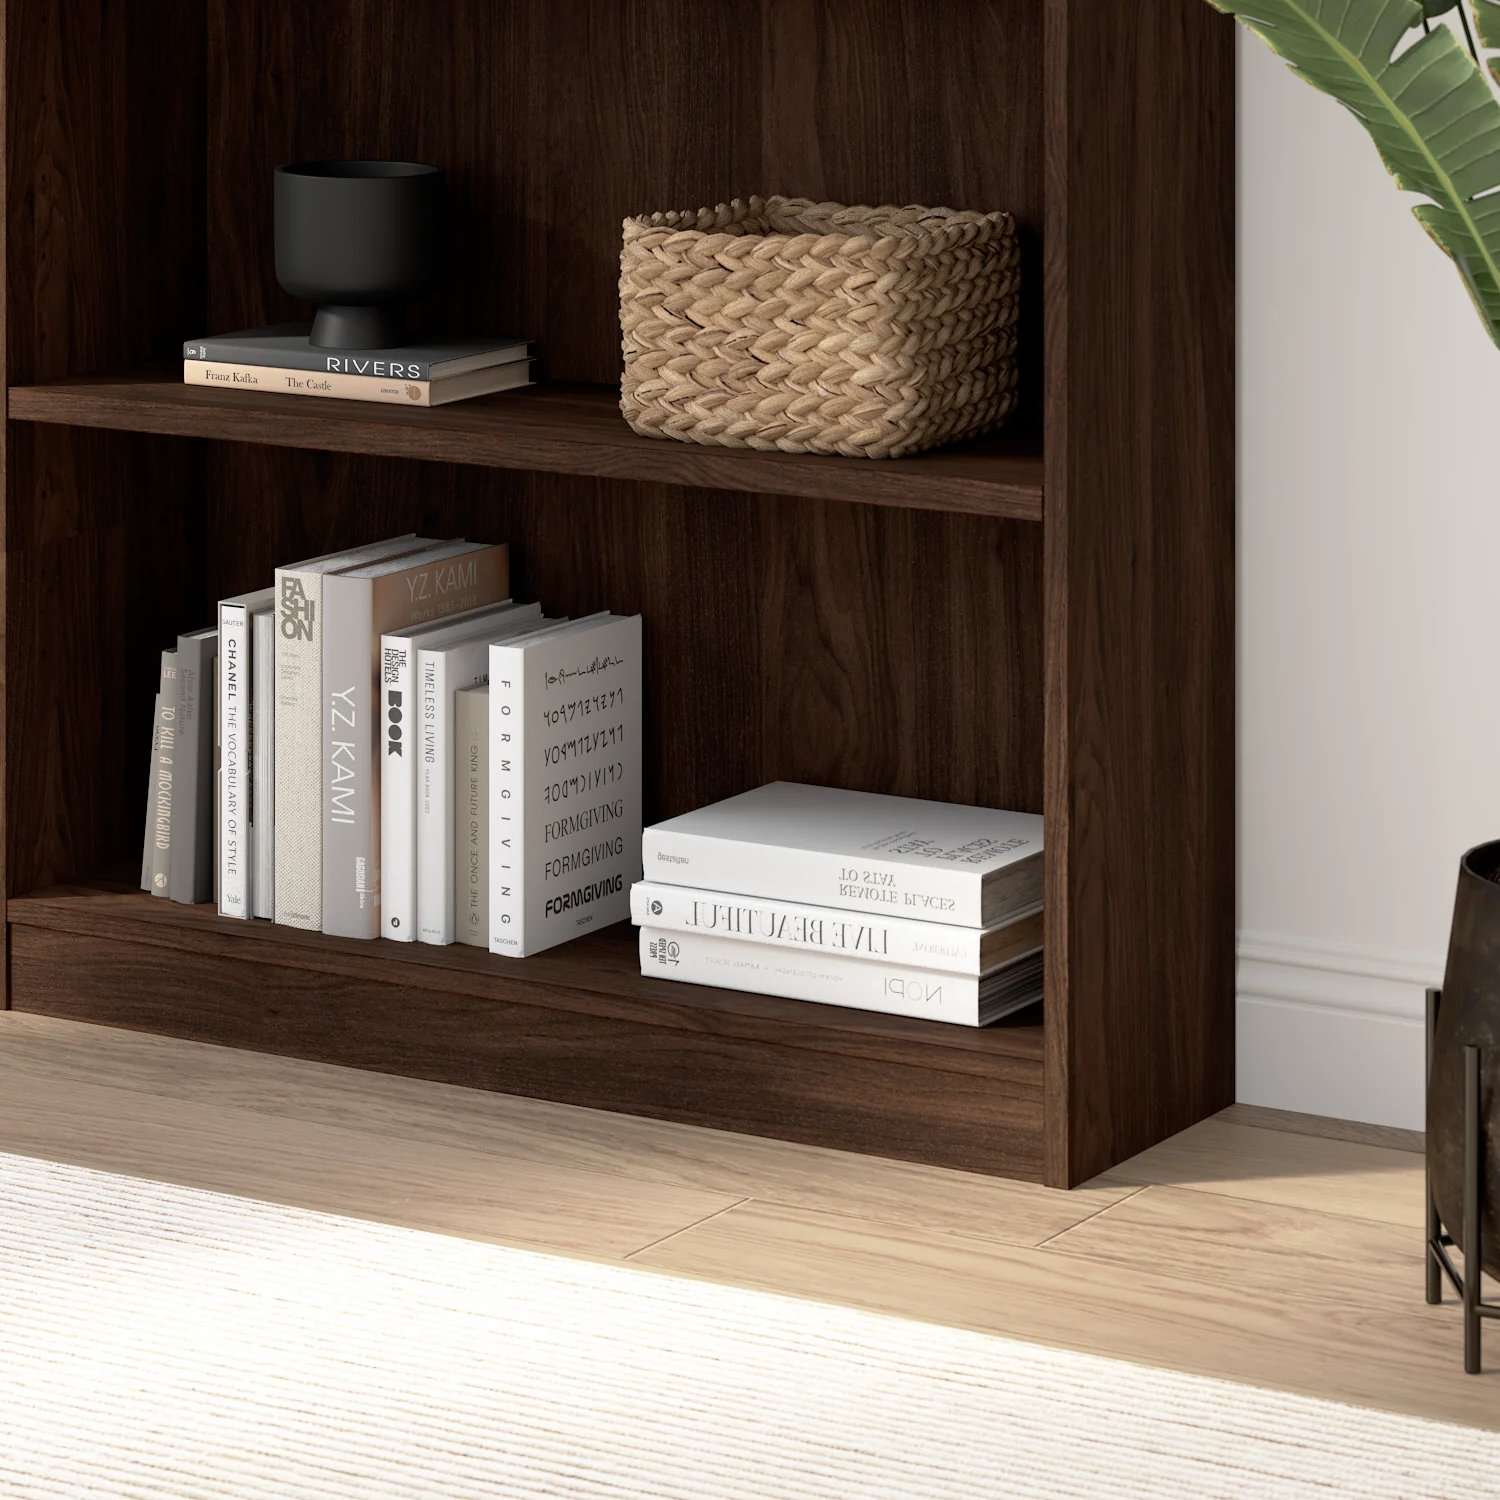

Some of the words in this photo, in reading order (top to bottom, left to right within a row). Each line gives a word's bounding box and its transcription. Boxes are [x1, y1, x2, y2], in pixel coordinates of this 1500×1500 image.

[205, 370, 230, 382] Franz
[232, 373, 258, 384] Kafka
[284, 377, 304, 388] The
[306, 379, 332, 390] Castle
[326, 357, 420, 379] RIVERS
[406, 572, 432, 602] Y.Z.
[435, 558, 477, 595] KAMI
[228, 638, 237, 700] CHANEL
[384, 648, 392, 683] HOTELS
[392, 648, 400, 682] DESIGN
[398, 650, 406, 668] THE
[332, 686, 356, 732] Y.Z.
[424, 662, 435, 720] TIMELESS
[228, 706, 236, 728] THE
[388, 690, 402, 758] BOOK
[424, 724, 435, 764] LIVING
[470, 744, 478, 772] KING
[228, 732, 237, 816] VOCABULARY
[331, 741, 356, 824] KAMI
[470, 777, 478, 816] FUTURE
[228, 818, 236, 836] OF
[470, 820, 478, 845] AND
[544, 799, 624, 844] FORMGIVING
[228, 840, 236, 876] STYLE
[470, 850, 478, 884] ONCE
[545, 836, 623, 881] FORMGIVING
[470, 889, 478, 908] THE
[545, 874, 623, 918] FORMGIVING
